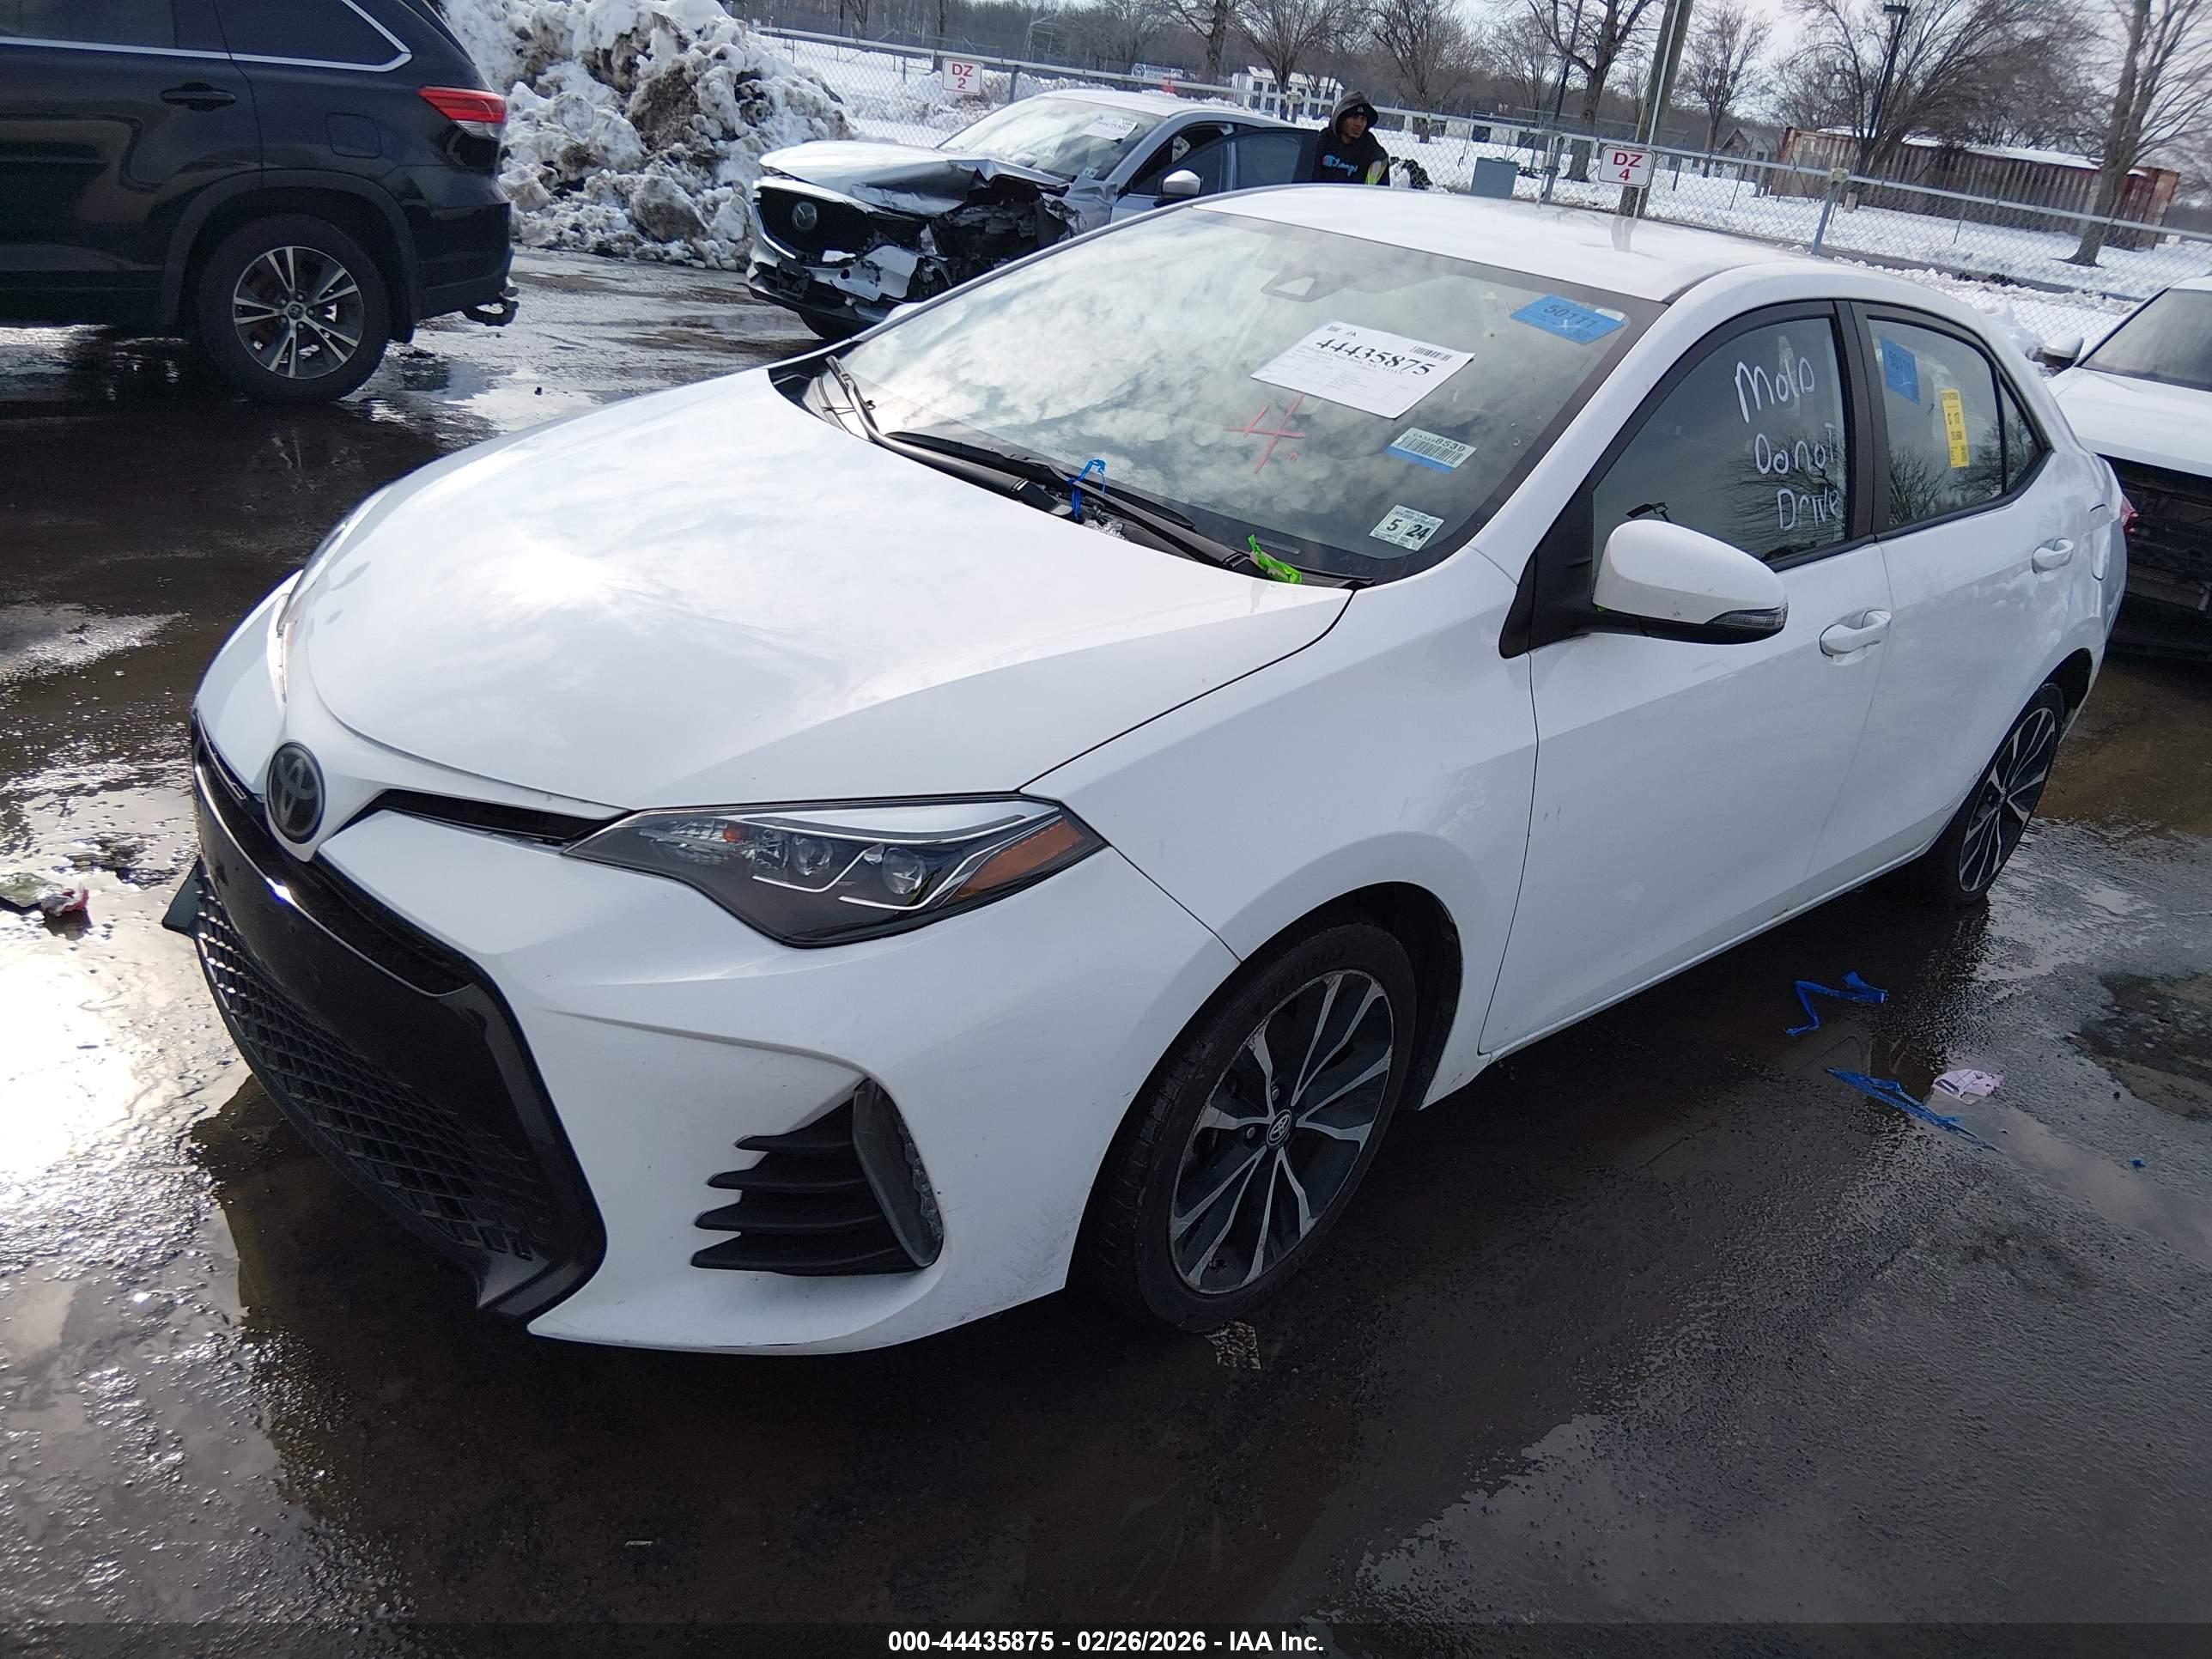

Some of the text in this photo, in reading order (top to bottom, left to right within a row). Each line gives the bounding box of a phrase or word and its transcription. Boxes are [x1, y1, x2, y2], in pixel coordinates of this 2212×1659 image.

[951, 64, 974, 77] DZ
[957, 77, 967, 89] 2
[1613, 152, 1644, 168] DZ
[1619, 168, 1630, 181] 4
[1316, 337, 1437, 376] 44435875
[1386, 519, 1403, 532] 5
[1406, 524, 1431, 540] 24
